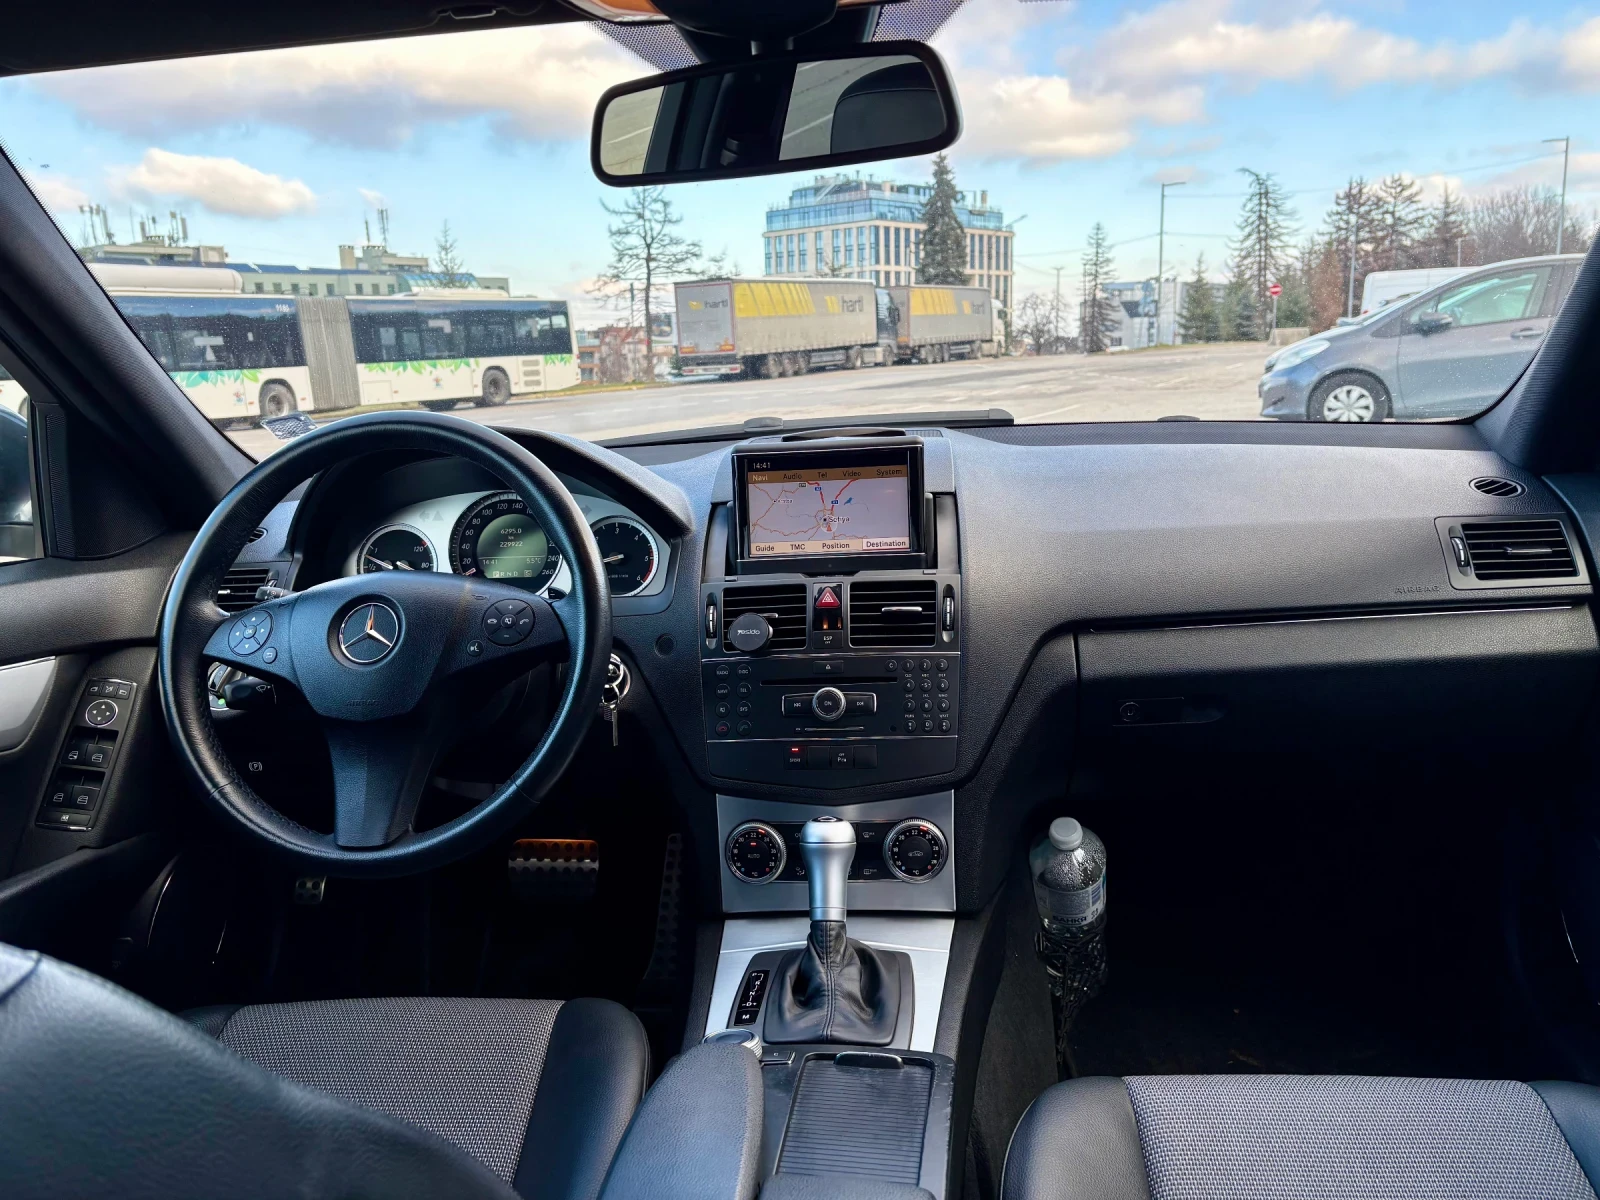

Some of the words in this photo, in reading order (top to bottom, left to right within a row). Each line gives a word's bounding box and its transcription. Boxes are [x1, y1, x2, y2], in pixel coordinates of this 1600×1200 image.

[704, 299, 728, 309] hartl
[783, 472, 802, 480] Audio
[842, 470, 862, 478] Video
[876, 468, 902, 477] System
[756, 545, 775, 553] Guide
[822, 542, 850, 550] Position
[866, 540, 906, 549] Destination
[1395, 586, 1440, 594] AIRBAG
